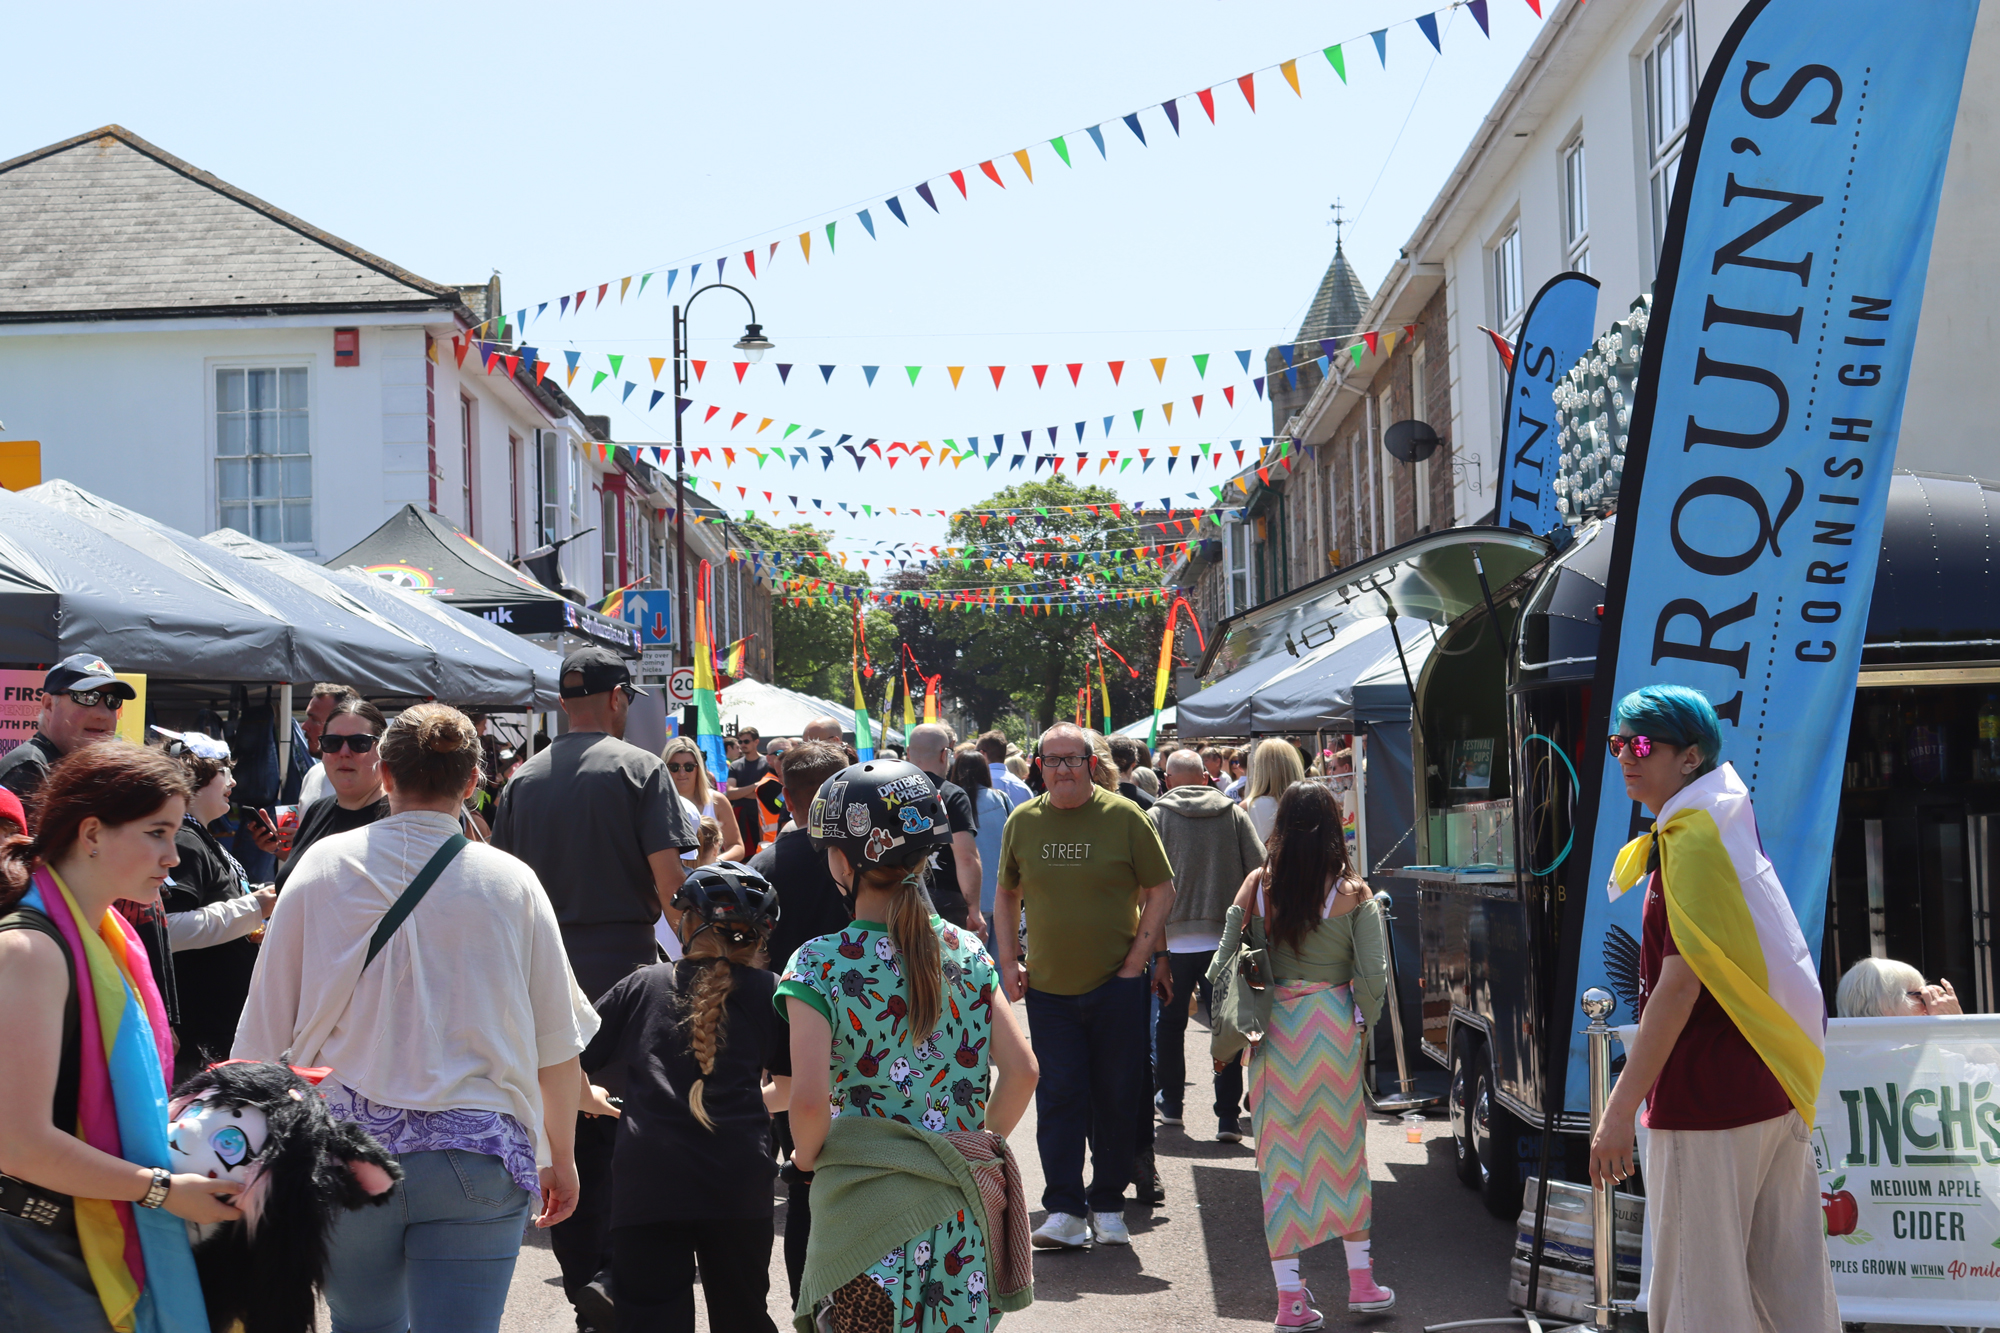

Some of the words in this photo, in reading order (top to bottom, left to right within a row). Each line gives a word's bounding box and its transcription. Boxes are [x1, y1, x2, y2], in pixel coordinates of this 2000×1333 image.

[1630, 60, 1844, 842] RQUIN'S
[1795, 417, 1873, 663] CORNISH
[1837, 295, 1892, 387] GIN
[4, 686, 45, 702] FIRS
[673, 677, 694, 691] 20
[22, 720, 39, 730] PR
[1462, 740, 1491, 751] FESTIVAL
[1473, 751, 1490, 762] CUPS
[876, 774, 926, 798] DIRTBIKE
[1041, 843, 1092, 860] STREET
[1839, 1082, 2000, 1167] INCH'S
[1516, 1135, 1566, 1158] CHIS
[1871, 1179, 1933, 1197] MEDIUM
[1938, 1180, 1982, 1198] APPLE
[1892, 1210, 1966, 1242] CIDER
[1861, 1259, 1907, 1276] GROWN
[1910, 1264, 1945, 1276] WITHIN
[1947, 1259, 1967, 1281] 40
